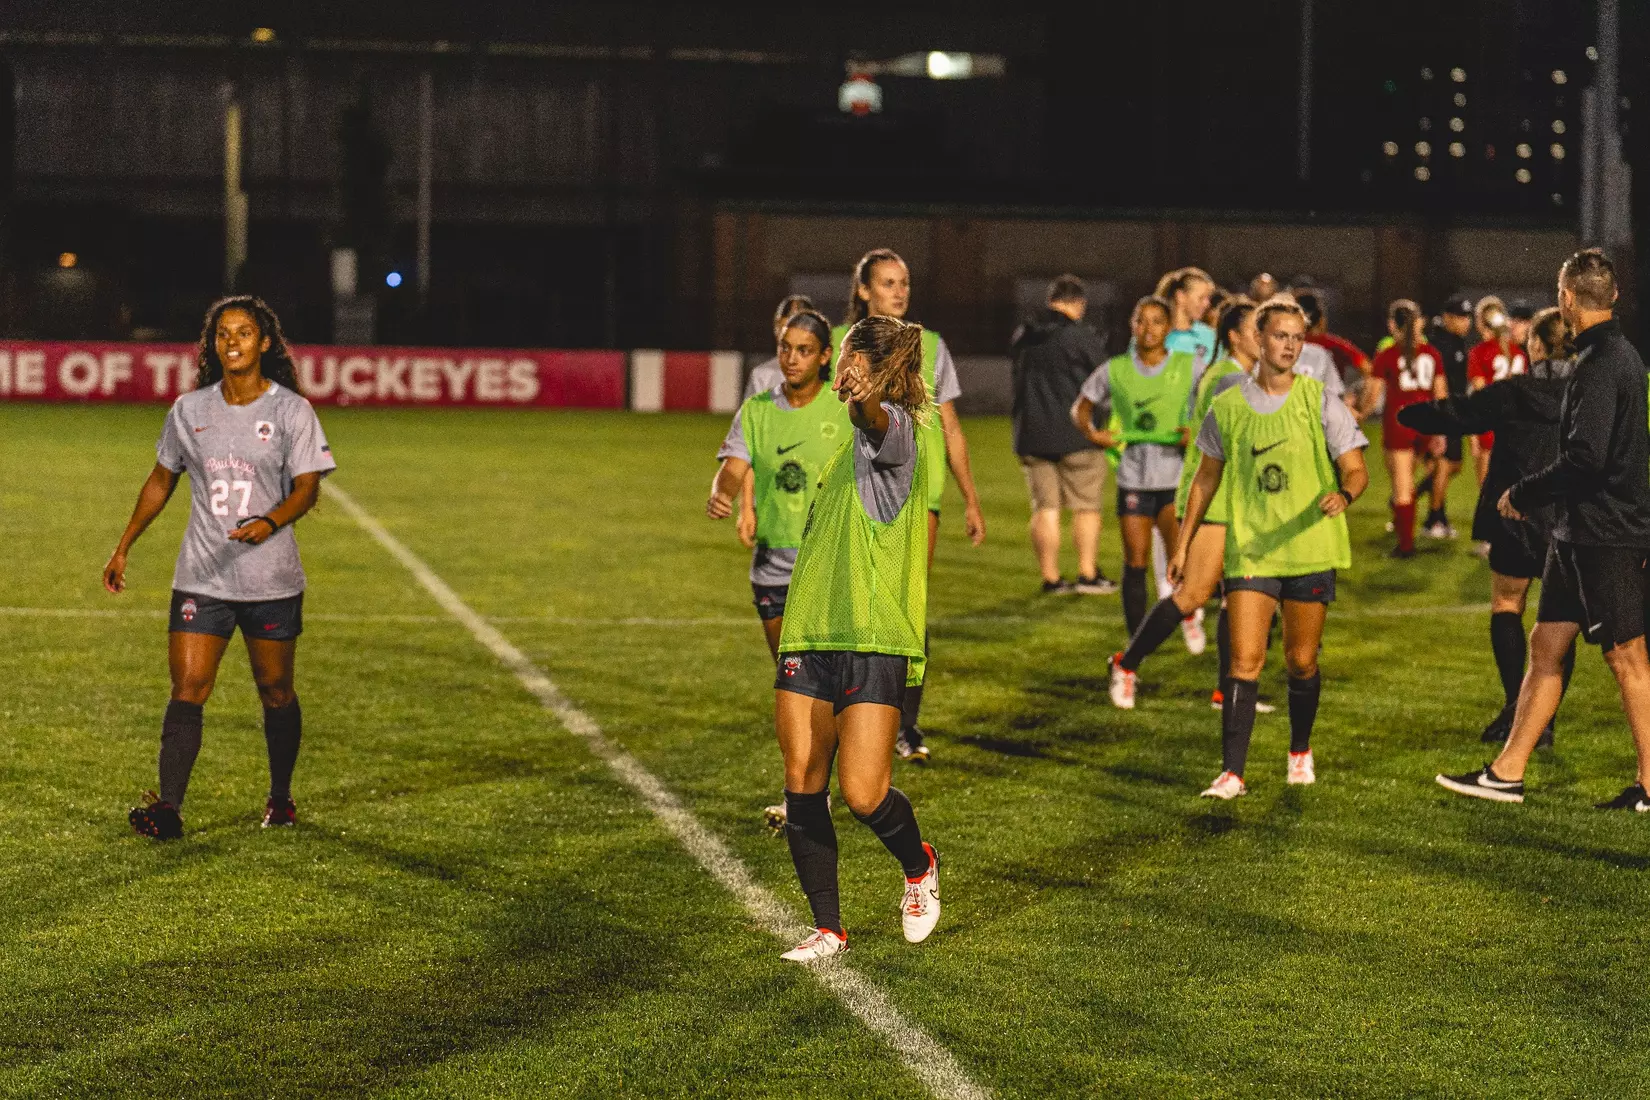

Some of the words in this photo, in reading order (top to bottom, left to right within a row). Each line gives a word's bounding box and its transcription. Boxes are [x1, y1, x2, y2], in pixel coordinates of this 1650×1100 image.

[0, 351, 46, 395] E
[57, 351, 133, 396] OF
[301, 354, 540, 401] UCKEYES
[211, 480, 252, 516] 27
